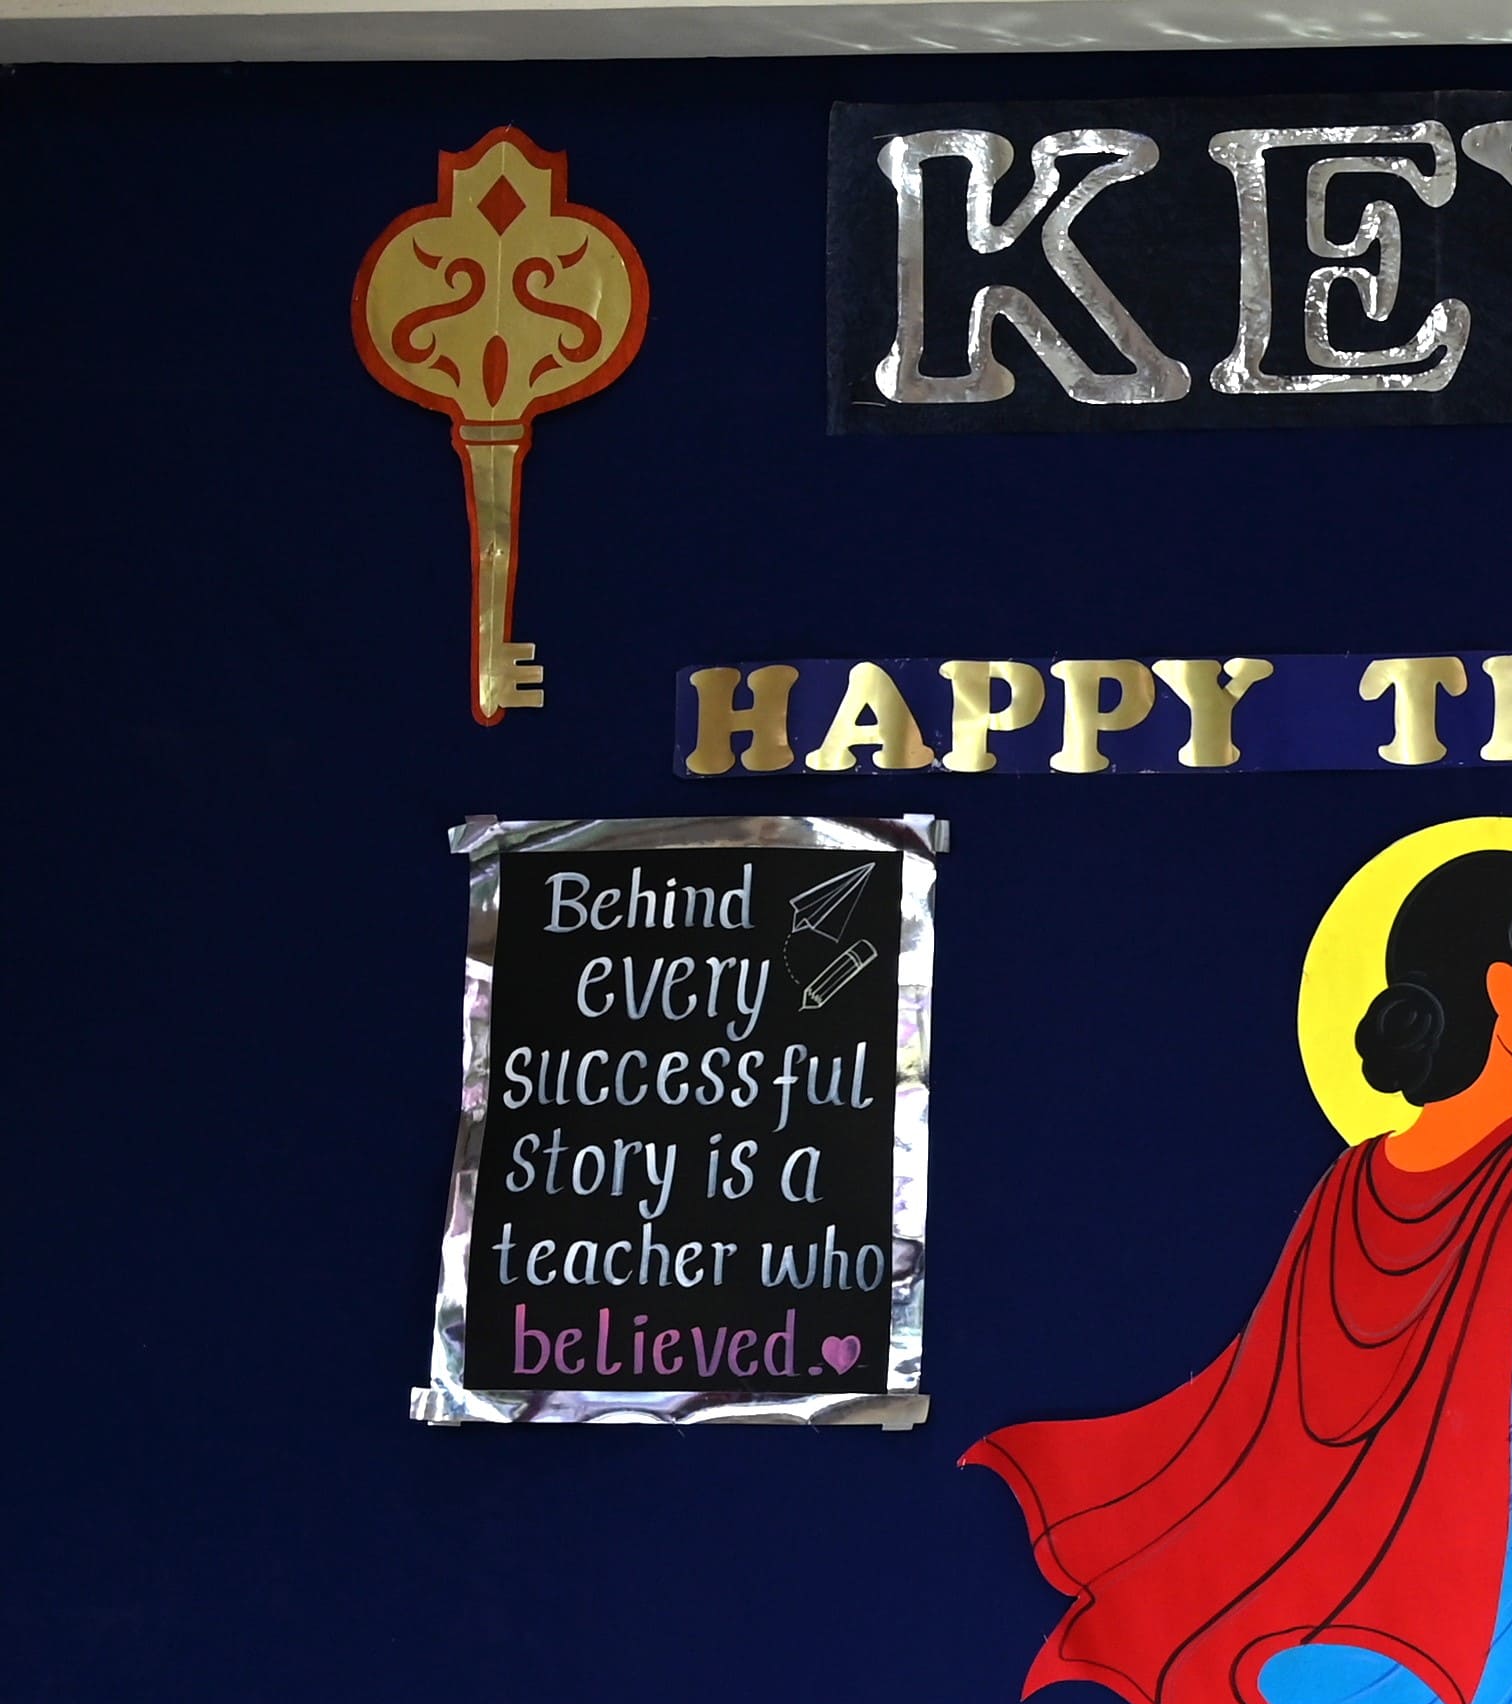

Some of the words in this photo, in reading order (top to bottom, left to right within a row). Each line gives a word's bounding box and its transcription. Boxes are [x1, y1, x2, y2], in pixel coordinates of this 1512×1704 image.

[684, 656, 1275, 776] HAPPY
[543, 862, 756, 934] Behind
[576, 954, 771, 1041] every
[502, 1042, 875, 1134] successful
[505, 1127, 677, 1221] story
[706, 1133, 760, 1201] is
[780, 1145, 824, 1203] a
[490, 1222, 738, 1286] teacher
[760, 1224, 885, 1293] who
[512, 1303, 824, 1378] believed.
